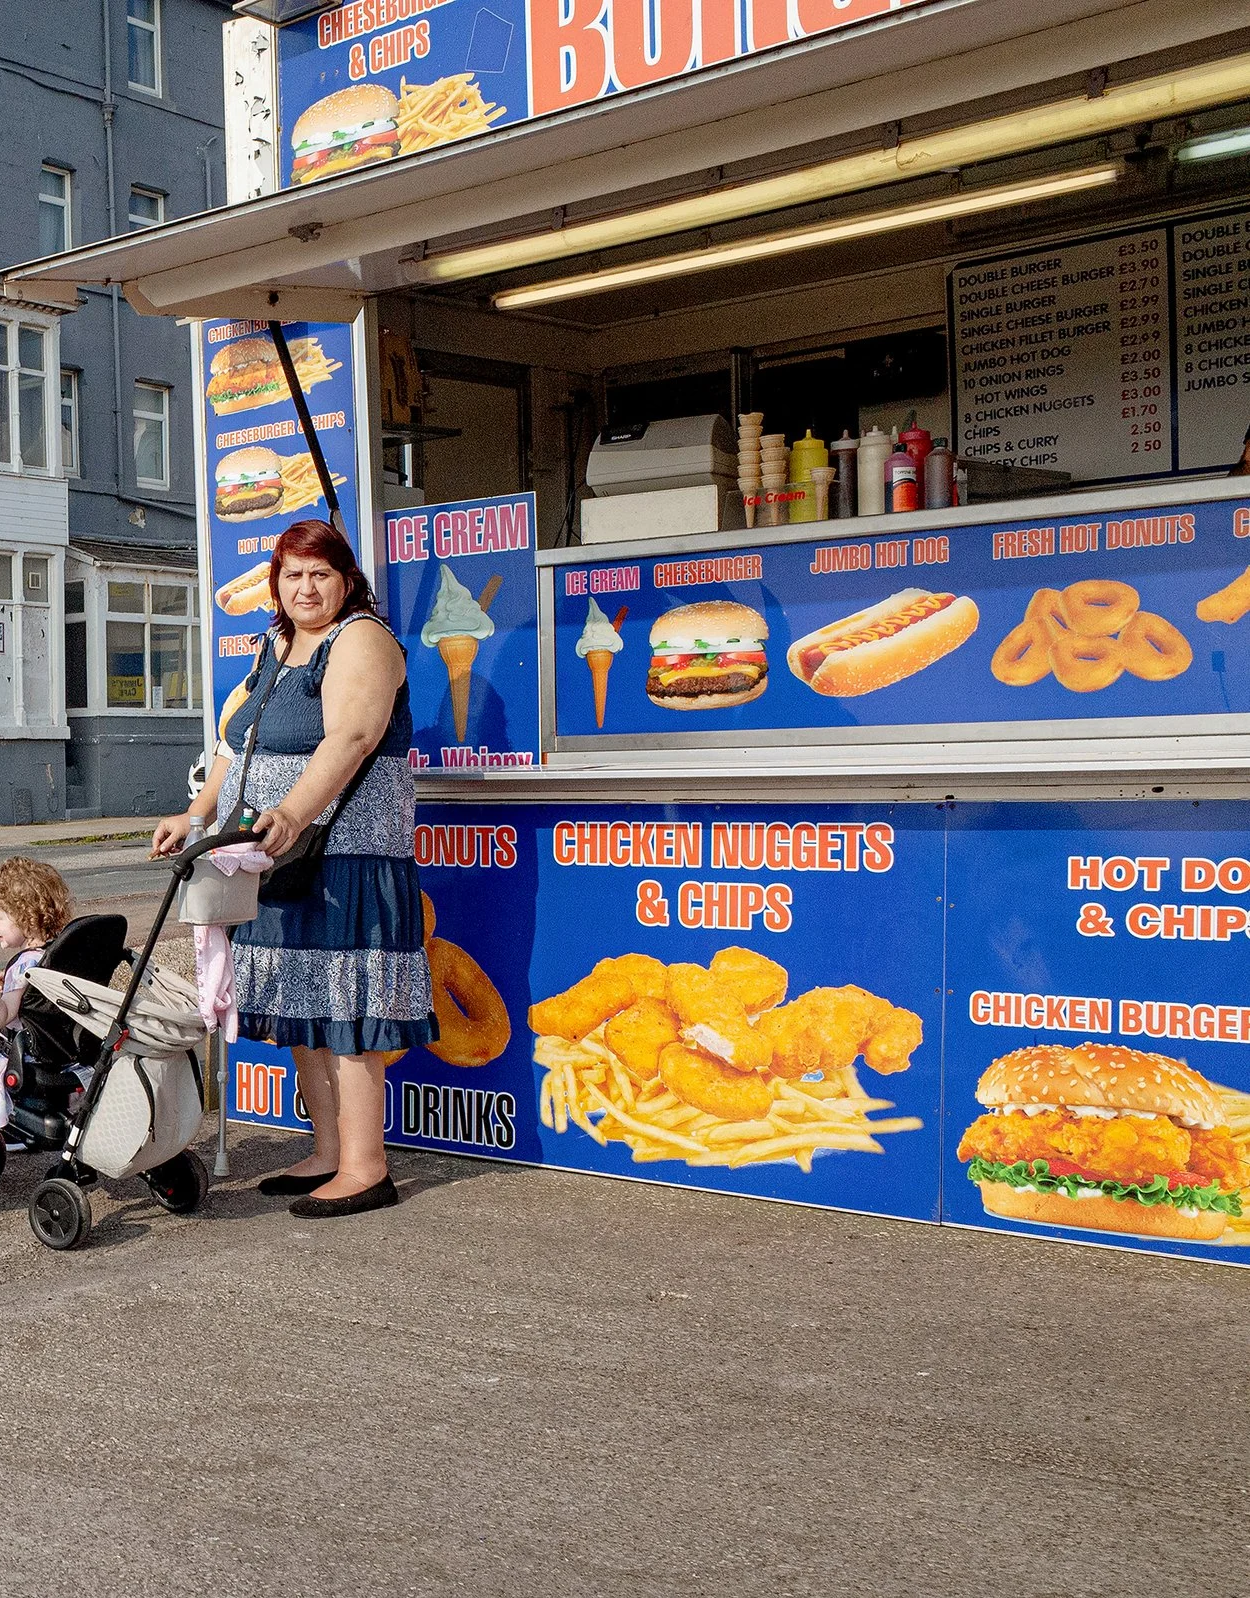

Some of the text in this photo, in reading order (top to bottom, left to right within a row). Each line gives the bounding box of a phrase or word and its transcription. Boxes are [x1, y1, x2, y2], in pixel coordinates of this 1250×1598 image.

[318, 0, 454, 49] CHEESEBU
[349, 20, 430, 81] & CHIPS
[1182, 223, 1240, 244] DOUBLE
[959, 239, 1158, 288] DOUBLE BURGER £3.50
[1183, 241, 1241, 263] DOUBLE
[959, 257, 1159, 305] DOUBLE CHEESE BURGER £3.90
[1182, 262, 1233, 281] SINGLE
[960, 276, 1159, 322] SINGLE BURGER £2.70
[1183, 281, 1233, 300] SINGLE
[1183, 297, 1249, 318] CHICKEN
[208, 320, 252, 343] CHICKEN
[961, 294, 1159, 339] SINGLE CHEESE BURGER £2.99
[962, 313, 1160, 356] CHICKEN FILLET BURGER £2.99
[1183, 318, 1237, 337] JUMBO
[962, 356, 1006, 373] JUMBO
[1010, 350, 1038, 365] HOT
[1041, 346, 1071, 360] DOG
[1184, 344, 1193, 355] 8
[1185, 362, 1194, 373] 8
[963, 349, 1161, 390] 10 ONION RINGS £2.00
[975, 367, 1161, 405] HOT WINGS £3.50
[1185, 374, 1238, 392] JUMBO
[964, 385, 1161, 424] 8 CHICKEN NUGGETS £3.00
[964, 403, 1157, 440] CHIPS £1.70
[216, 420, 295, 449] CHEESEBURGER
[964, 421, 1161, 457] CHIPS & CURRY 2.50
[1021, 453, 1058, 467] CHIPS
[743, 490, 806, 506] Ice Cream
[238, 537, 259, 554] HOT
[388, 502, 529, 564] ICE CREAM
[992, 527, 1055, 561] FRESH
[1059, 522, 1100, 556] HOT
[1106, 513, 1195, 550] DONUTS
[654, 554, 763, 589] CHEESEBURGER
[810, 535, 949, 575] JUMBO HOT DOG
[565, 566, 640, 596] ICE CREAM
[553, 820, 895, 873] CHICKEN NUGGETS
[1068, 856, 1170, 891] HOT
[636, 879, 793, 932] & CHIPS
[1076, 902, 1250, 941] & CHIP
[969, 990, 1112, 1034] CHICKEN
[236, 1061, 287, 1117] HOT
[401, 1081, 515, 1150] DRINKS
